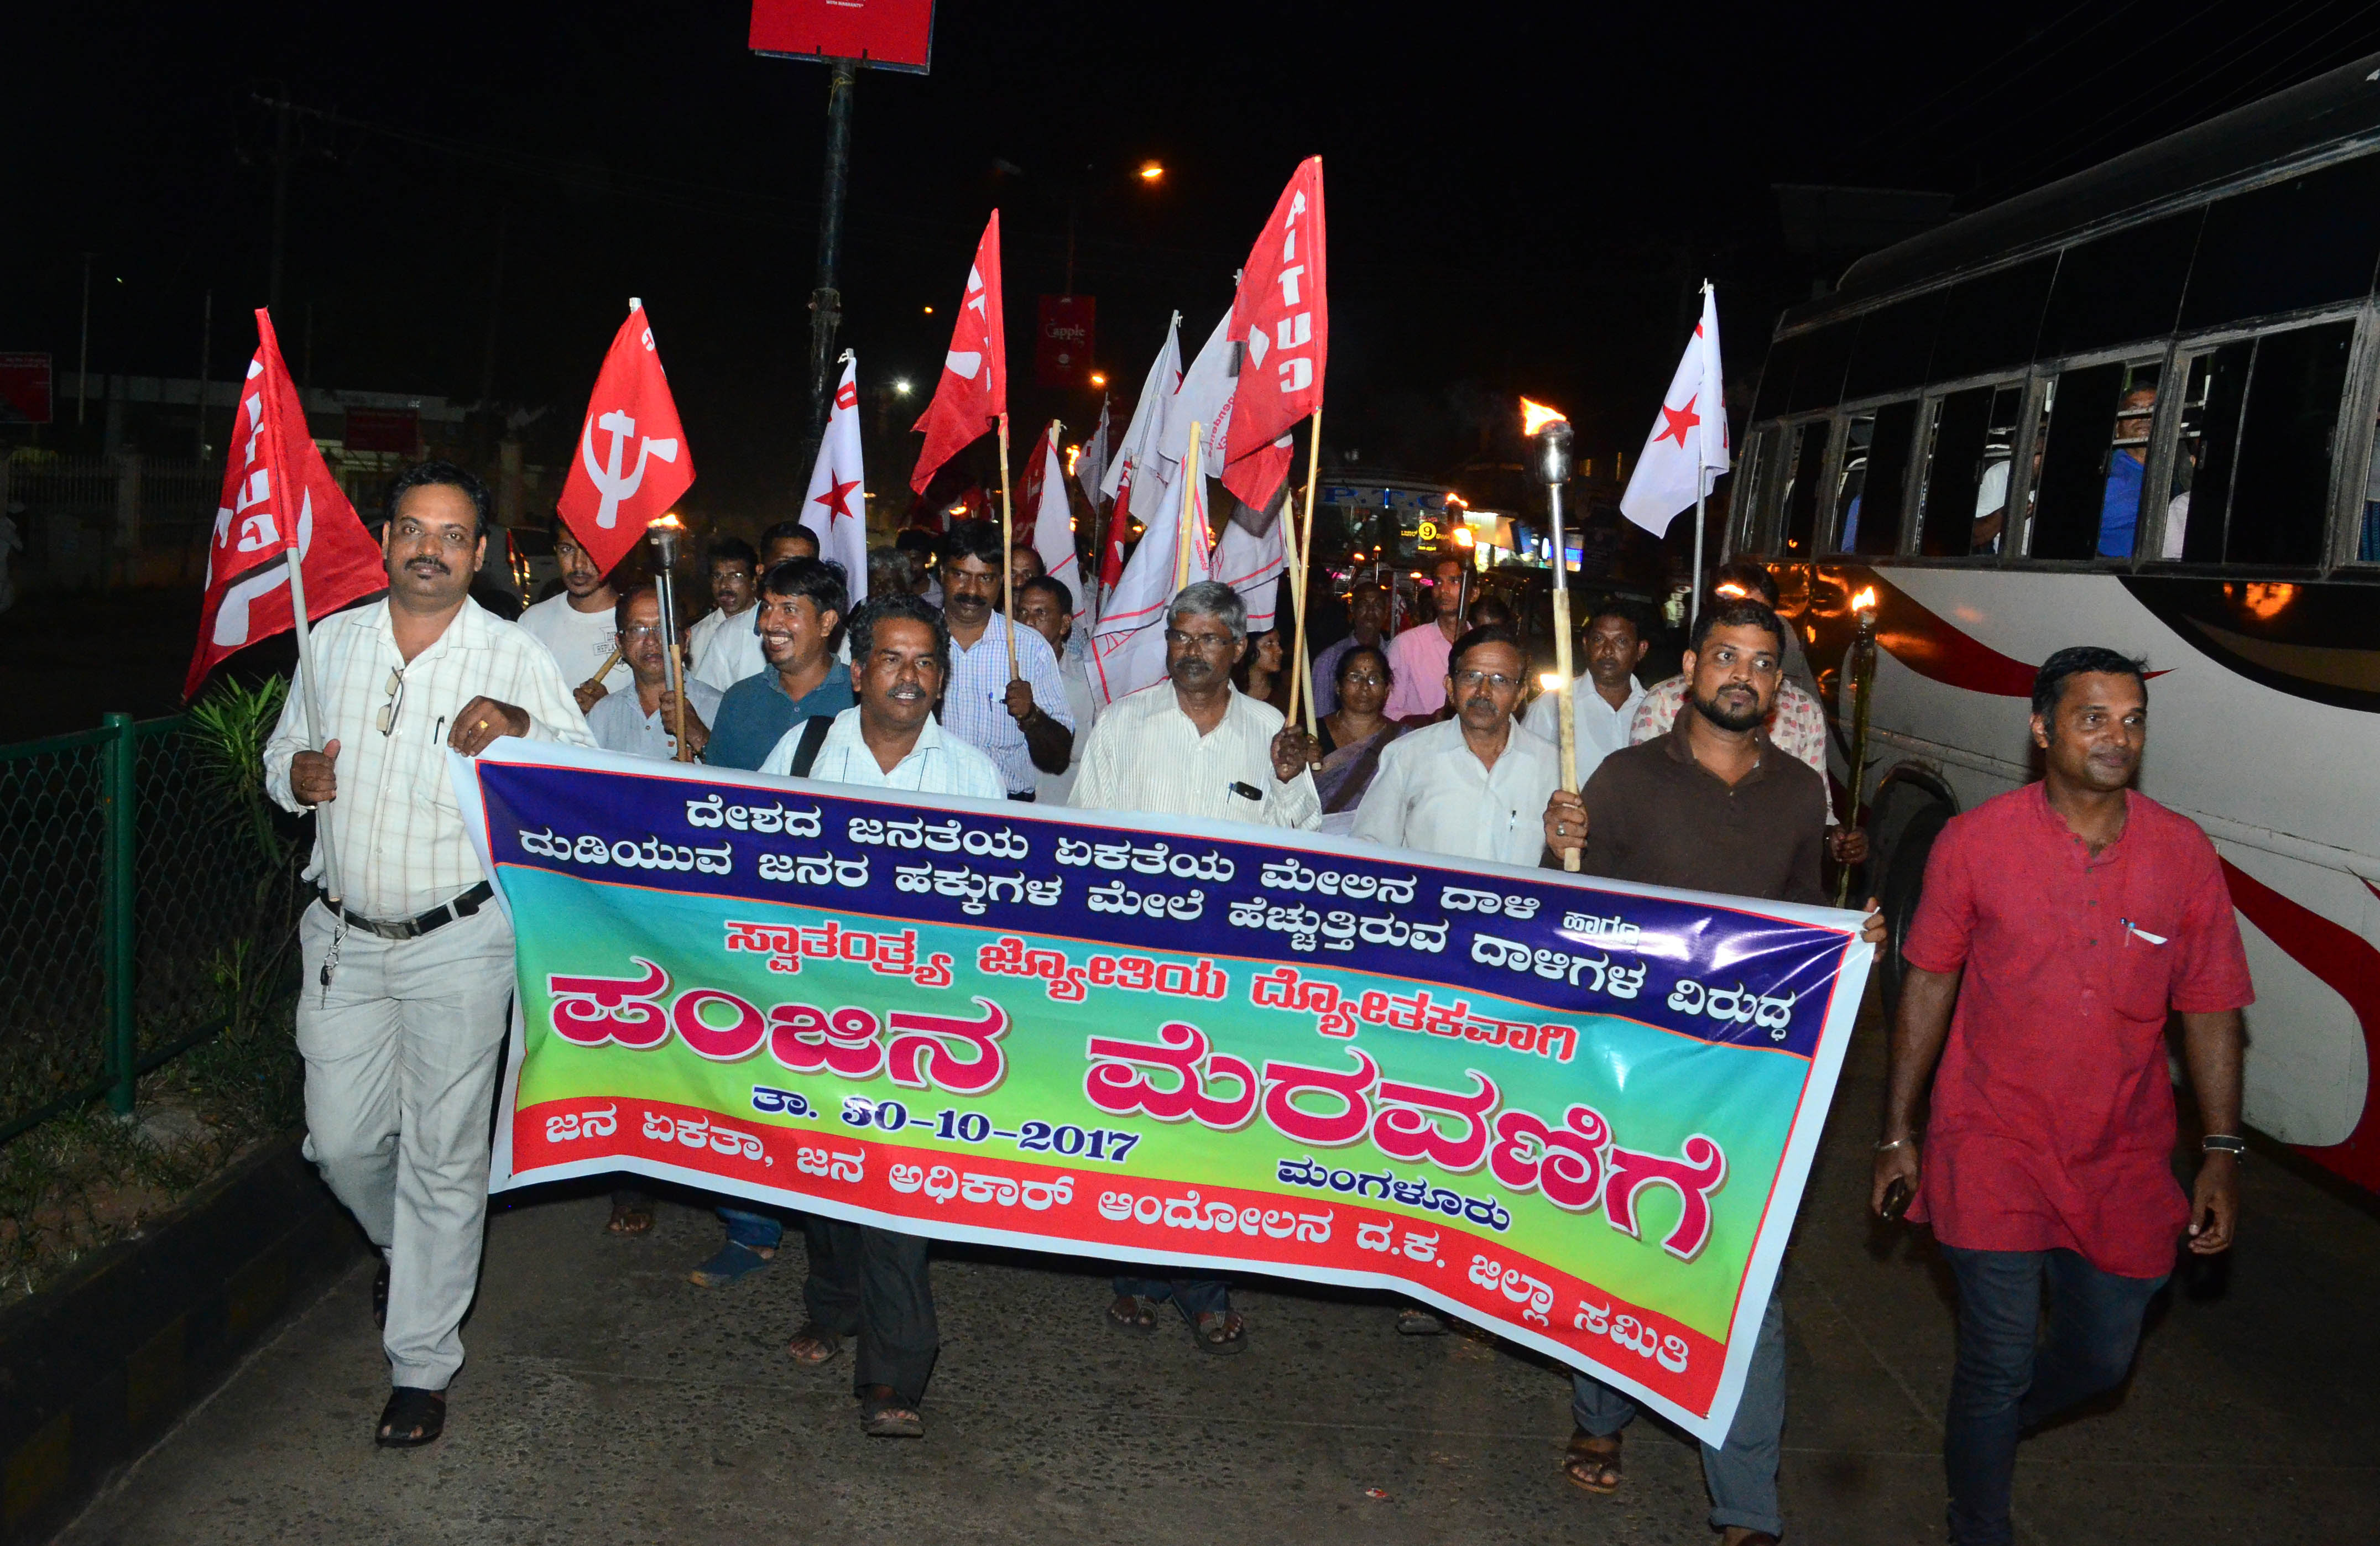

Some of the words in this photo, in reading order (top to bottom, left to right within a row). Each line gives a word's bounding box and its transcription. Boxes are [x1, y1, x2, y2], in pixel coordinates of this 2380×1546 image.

[1423, 526, 1432, 536] 9
[687, 795, 821, 838] ದೇಶದ
[849, 818, 1028, 859] ಜನತೆಯ
[1055, 837, 1234, 882] ಏಕತೆಯ
[1261, 859, 1417, 903] ಮೇಲಿನ
[1440, 886, 1540, 919] ದಾಳಿ
[519, 828, 731, 875] ದುಡಿಯುವ
[759, 851, 868, 887] ಜನರ
[896, 861, 1062, 915] ಹಕ್ಕುಗಳ
[1088, 880, 1204, 921] ಮೇಲೆ
[1229, 897, 1449, 952] ಹೆಚ್ಚುತ್ತಿರುವ
[1471, 933, 1646, 999] ದಾಳಿಗಳ
[1667, 980, 1796, 1041] ವಿರುದ್ಧ
[724, 918, 954, 990] ಸ್ವಾತಂತ್ರ್ಯ
[977, 934, 1229, 1005] ಜ್ಯೋತಿಯ
[1249, 964, 1580, 1065] ದ್ಯೋತಕವಾಗಿ
[546, 956, 1010, 1095] ಪಂಜಿನ
[1085, 1020, 1727, 1262] ಮೆರವಣಿಗೆ
[751, 1084, 818, 1119] ತಾ.
[546, 1104, 617, 1143] ಜನ
[643, 1111, 774, 1167] ಏಕತಾ,
[797, 1147, 865, 1183] ಜನ
[889, 1160, 1074, 1211] ಅಧಿಕಾರ್
[1098, 1190, 1334, 1243] ಆಂದೋಲನ
[1468, 1255, 1554, 1327] ಜಿಲ್ಲಾ
[1574, 1300, 1689, 1373] ಸಮಿತಿ
[1276, 1153, 1512, 1234] ಮಂಗಳೂರು
